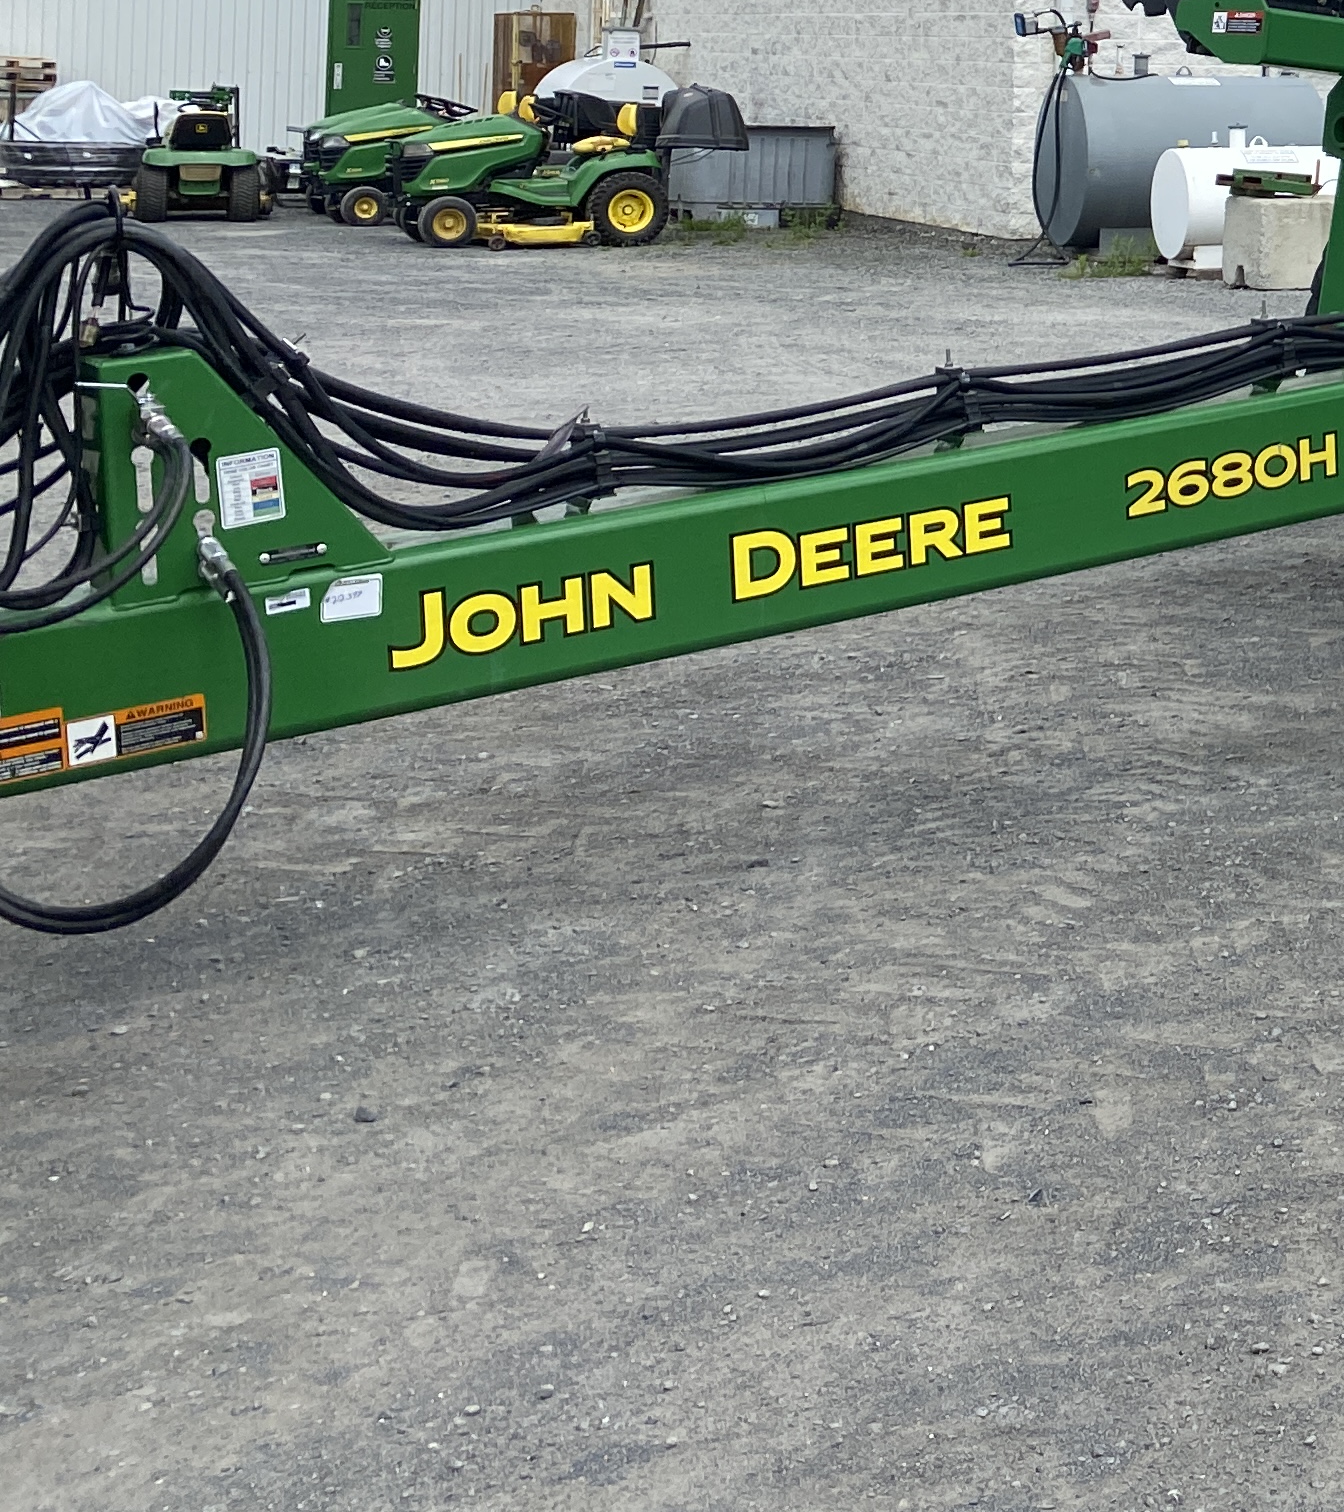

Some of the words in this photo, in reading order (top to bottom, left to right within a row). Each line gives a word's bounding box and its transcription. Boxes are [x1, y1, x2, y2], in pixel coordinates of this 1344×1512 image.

[221, 453, 275, 467] INFORMATION
[1126, 431, 1339, 519] 2680H
[389, 561, 655, 671] JOHN
[730, 495, 1012, 602] DEERE
[136, 698, 194, 718] WARNING
